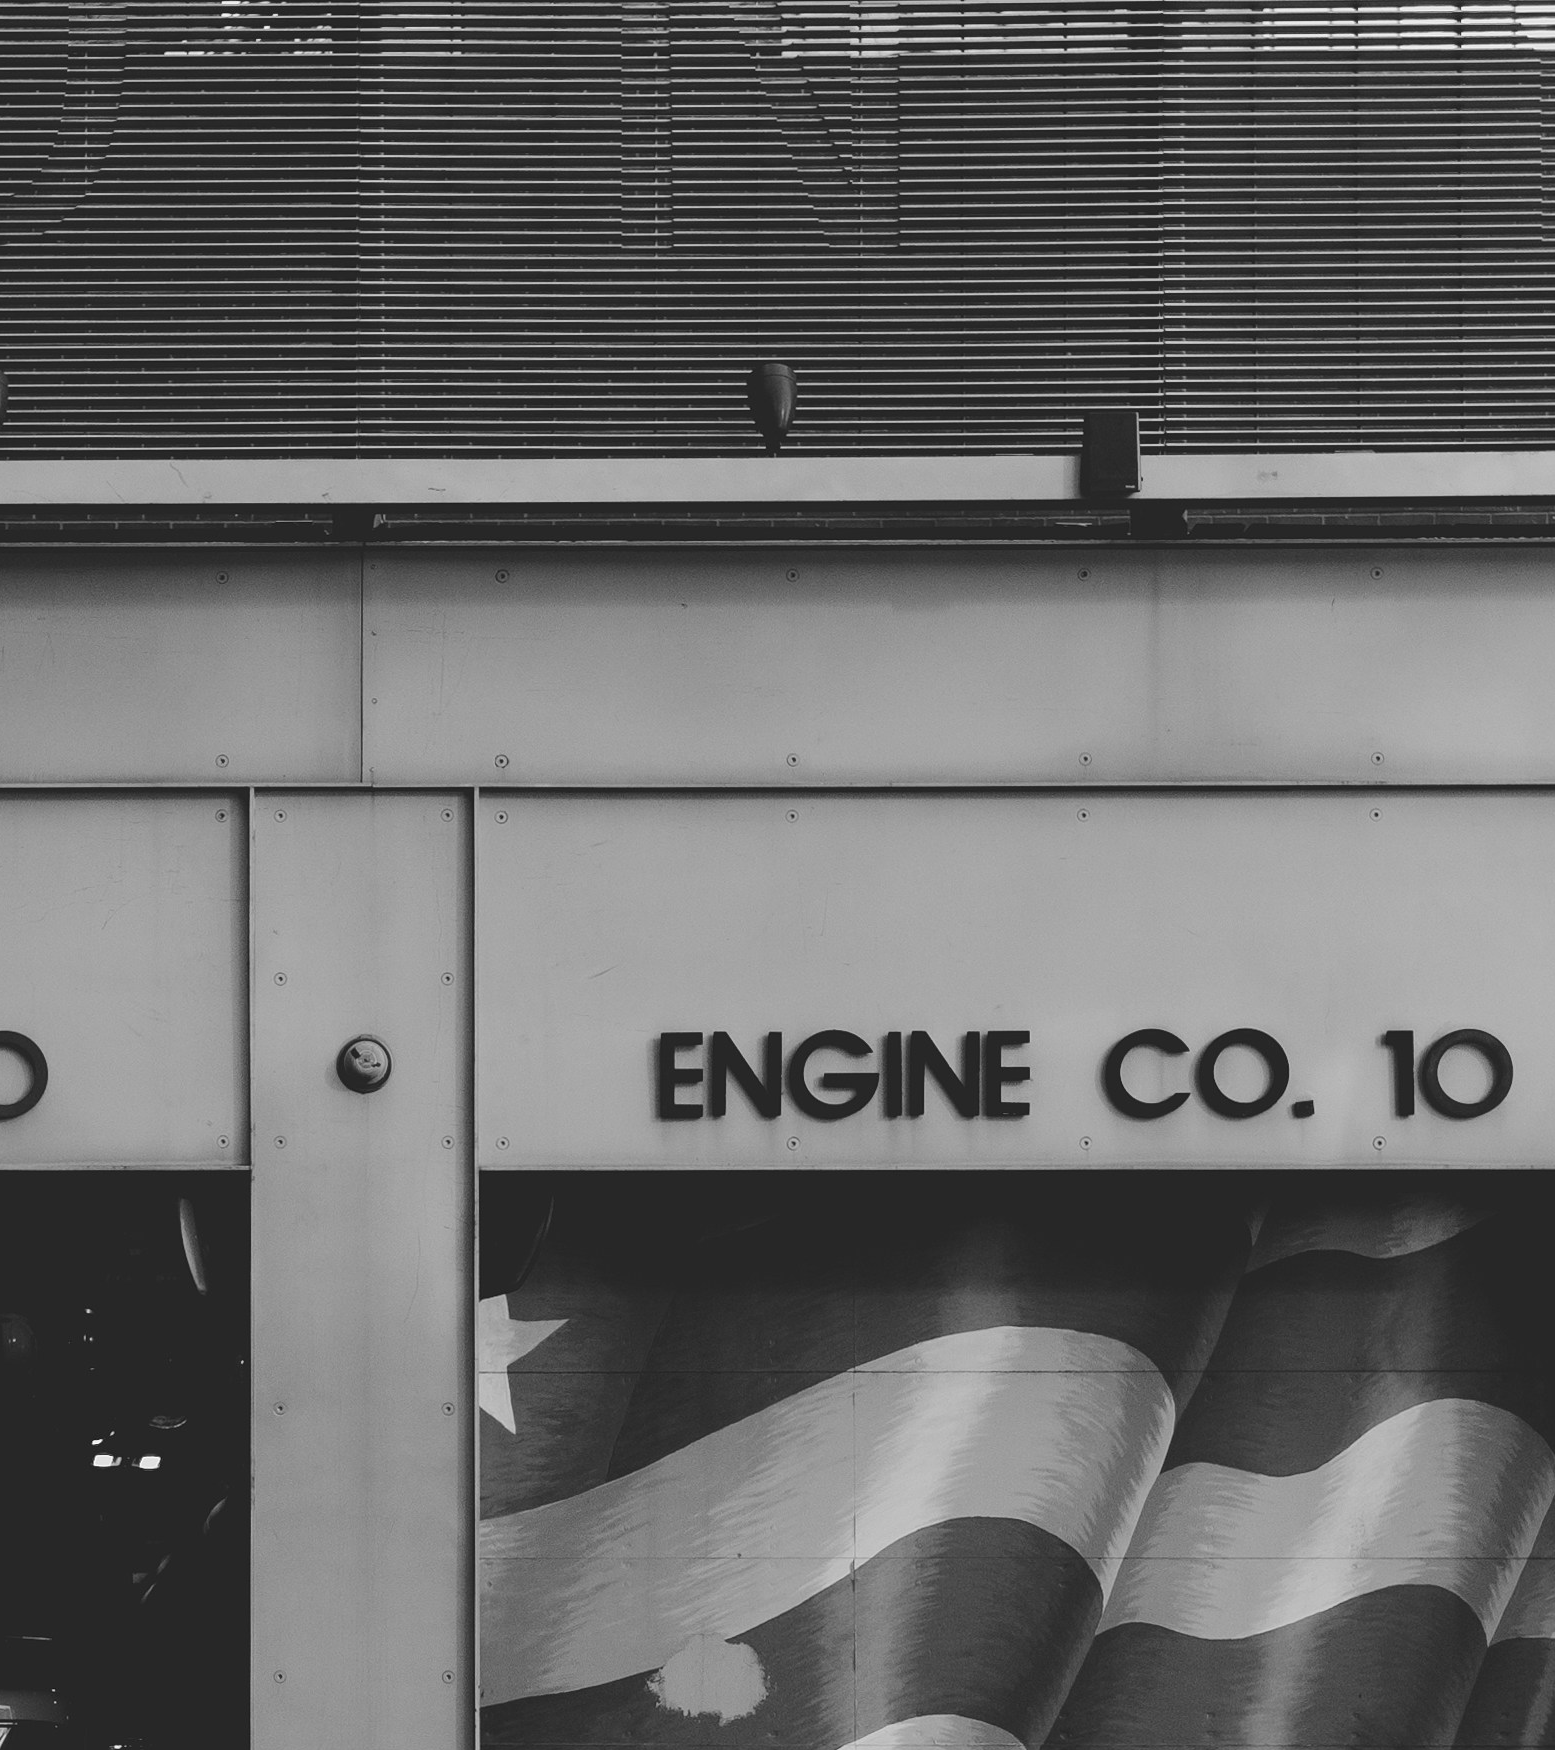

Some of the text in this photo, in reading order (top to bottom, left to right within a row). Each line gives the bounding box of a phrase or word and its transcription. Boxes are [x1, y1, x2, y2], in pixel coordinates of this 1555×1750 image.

[657, 1028, 1514, 1120] ENGINE CO. 10
